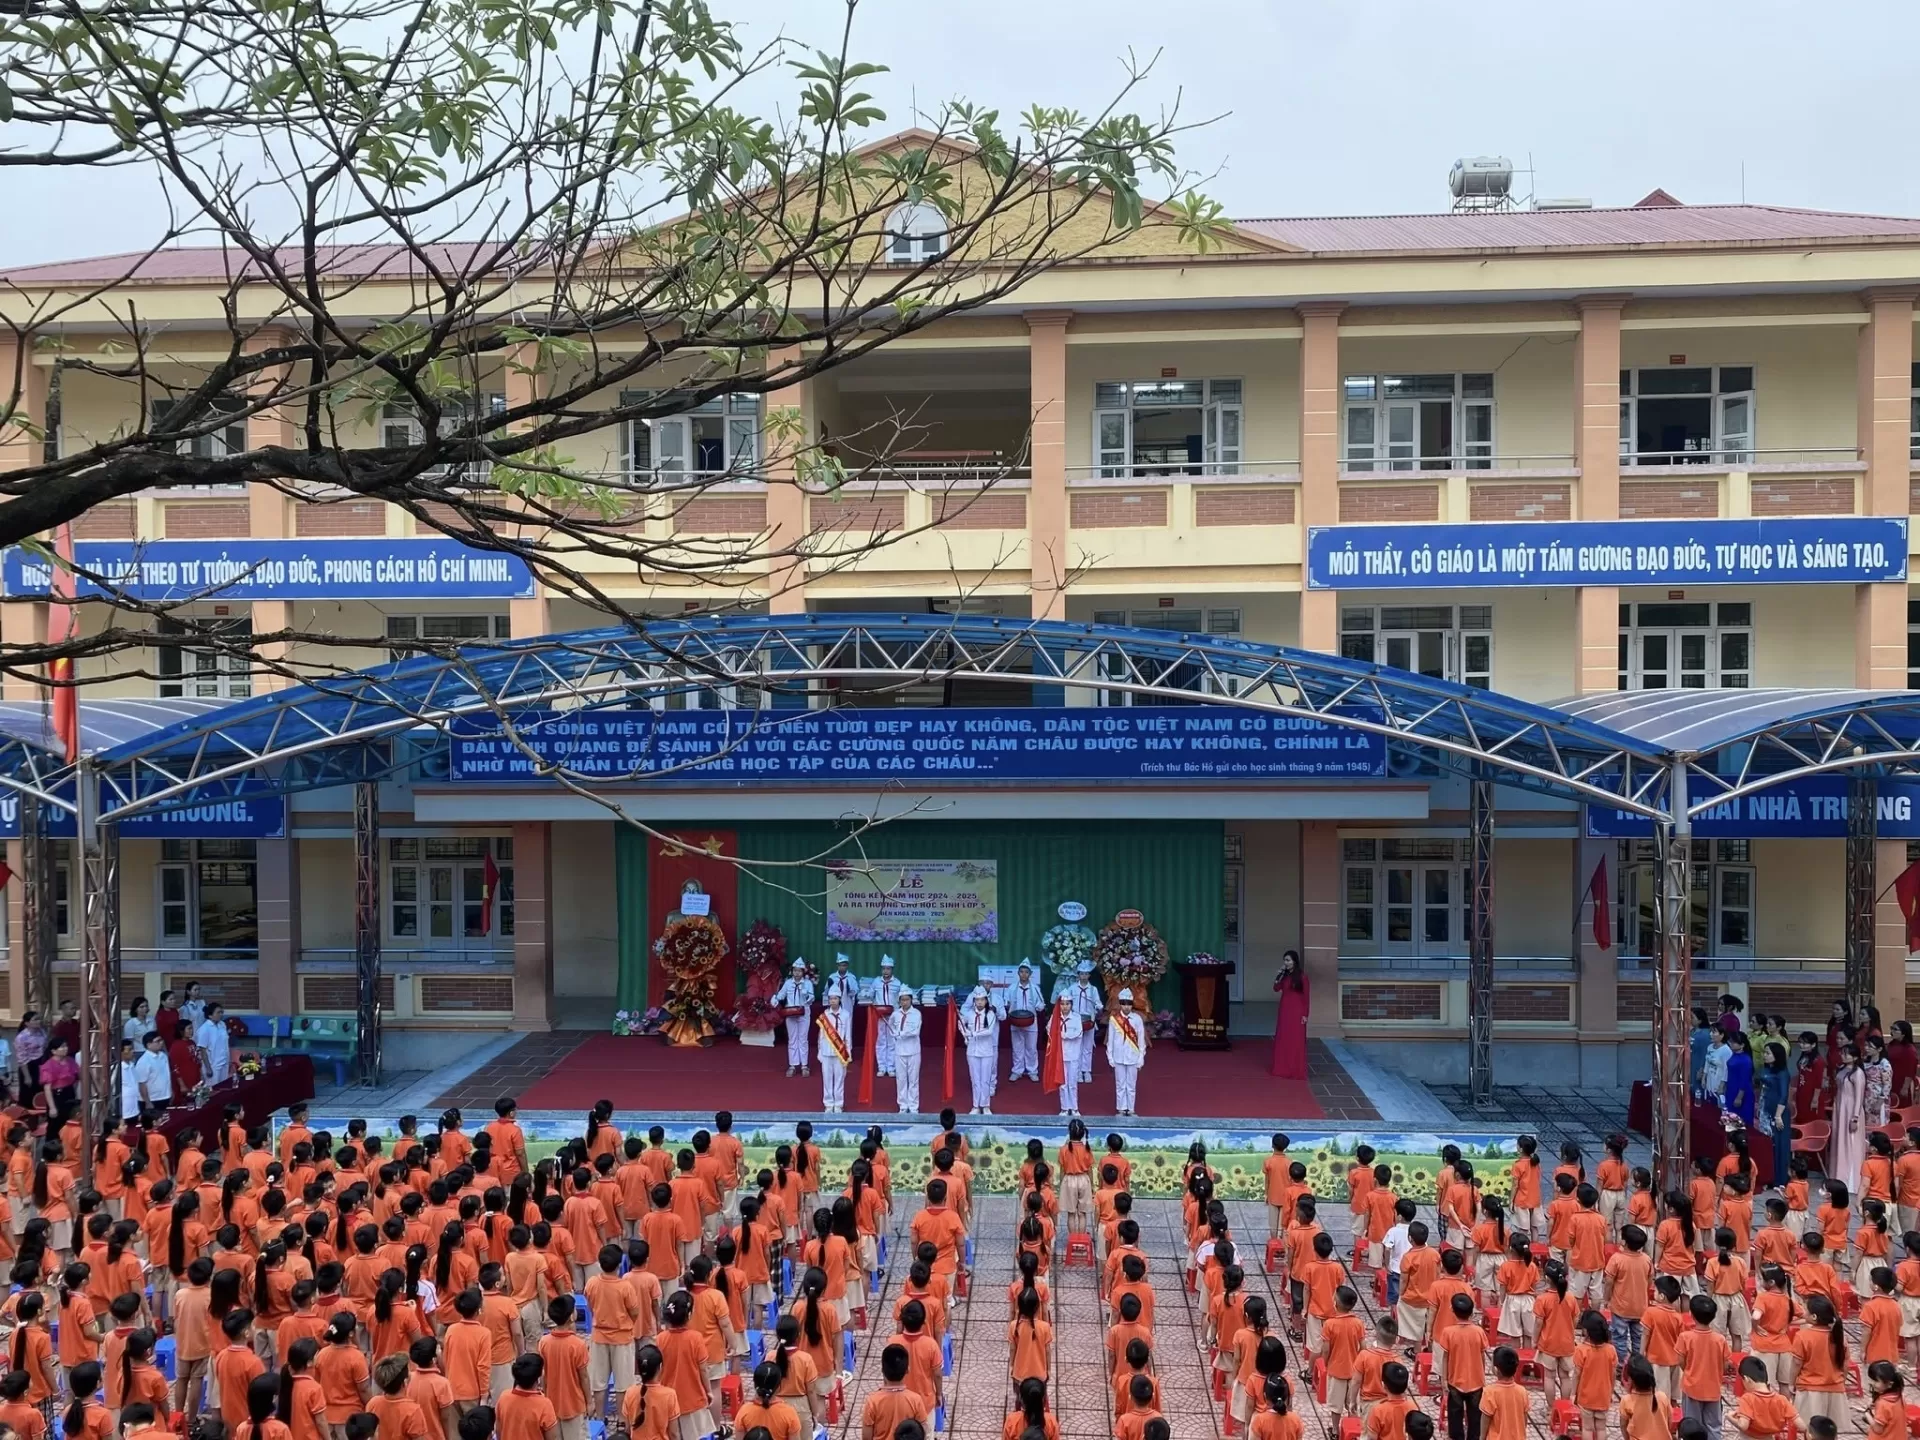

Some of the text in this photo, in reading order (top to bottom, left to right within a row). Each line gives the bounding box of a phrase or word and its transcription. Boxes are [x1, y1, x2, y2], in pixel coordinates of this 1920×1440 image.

[1328, 537, 1889, 578] MỖI THẦY, CÔ GIÁO LÀ MỘT TẤM GƯƠNG ĐẠO ĐỨC, TỰ HỌC VÀ SÁNG TẠO.
[141, 561, 177, 585] THEO
[181, 560, 200, 585] TƯ
[203, 551, 253, 587] TƯỞNG,
[256, 560, 285, 588] ĐẠO
[289, 554, 322, 586] ĐỨC,
[324, 560, 372, 584] PHONG
[376, 554, 415, 583] CÁCH
[418, 551, 437, 583] HỒ
[441, 554, 466, 582] CHÍ
[469, 559, 513, 582] MINH.
[544, 719, 599, 736] SÔNG
[603, 719, 646, 738] VIỆT
[653, 722, 697, 735] NAM
[778, 718, 819, 734] NÊN
[825, 719, 868, 734] TƯƠI
[874, 720, 913, 736] ĐẸP
[919, 719, 958, 733] HAY
[964, 716, 1037, 733] KHÔNG,
[1044, 716, 1086, 732] DÂN
[1092, 716, 1130, 735] TỘC
[1136, 716, 1179, 734] VIỆT
[1185, 718, 1233, 732] NAM
[1239, 715, 1267, 731] CÓ
[462, 738, 495, 754] ĐÀI
[554, 740, 620, 755] QUANG
[658, 737, 712, 752] SÁNH
[755, 735, 786, 752] VỚI
[792, 735, 831, 752] CÁC
[838, 735, 906, 752] CƯỜNG
[912, 734, 965, 752] QUỐC
[971, 735, 1018, 751] NĂM
[1024, 735, 1078, 751] CHÂU
[1084, 737, 1138, 753] ĐƯỢC
[1145, 737, 1185, 750] HAY
[1191, 734, 1268, 751] KHÔNG,
[1274, 734, 1338, 750] CHÍNH
[1344, 733, 1371, 749] LÀ
[463, 755, 505, 772] NHỜ
[617, 754, 654, 772] LỚN
[661, 755, 675, 771] Ở
[741, 757, 780, 773] HỌC
[787, 755, 825, 773] TẬP
[830, 753, 871, 770] CỦA
[877, 754, 916, 770] CÁC
[1140, 761, 1371, 774] (Trích thư Bác Hồ gửi cho học sinh tháng 9 năm 1945)
[1749, 789, 1802, 820] NHÀ
[1809, 796, 1911, 821] TRNG
[900, 874, 924, 889] LỄ
